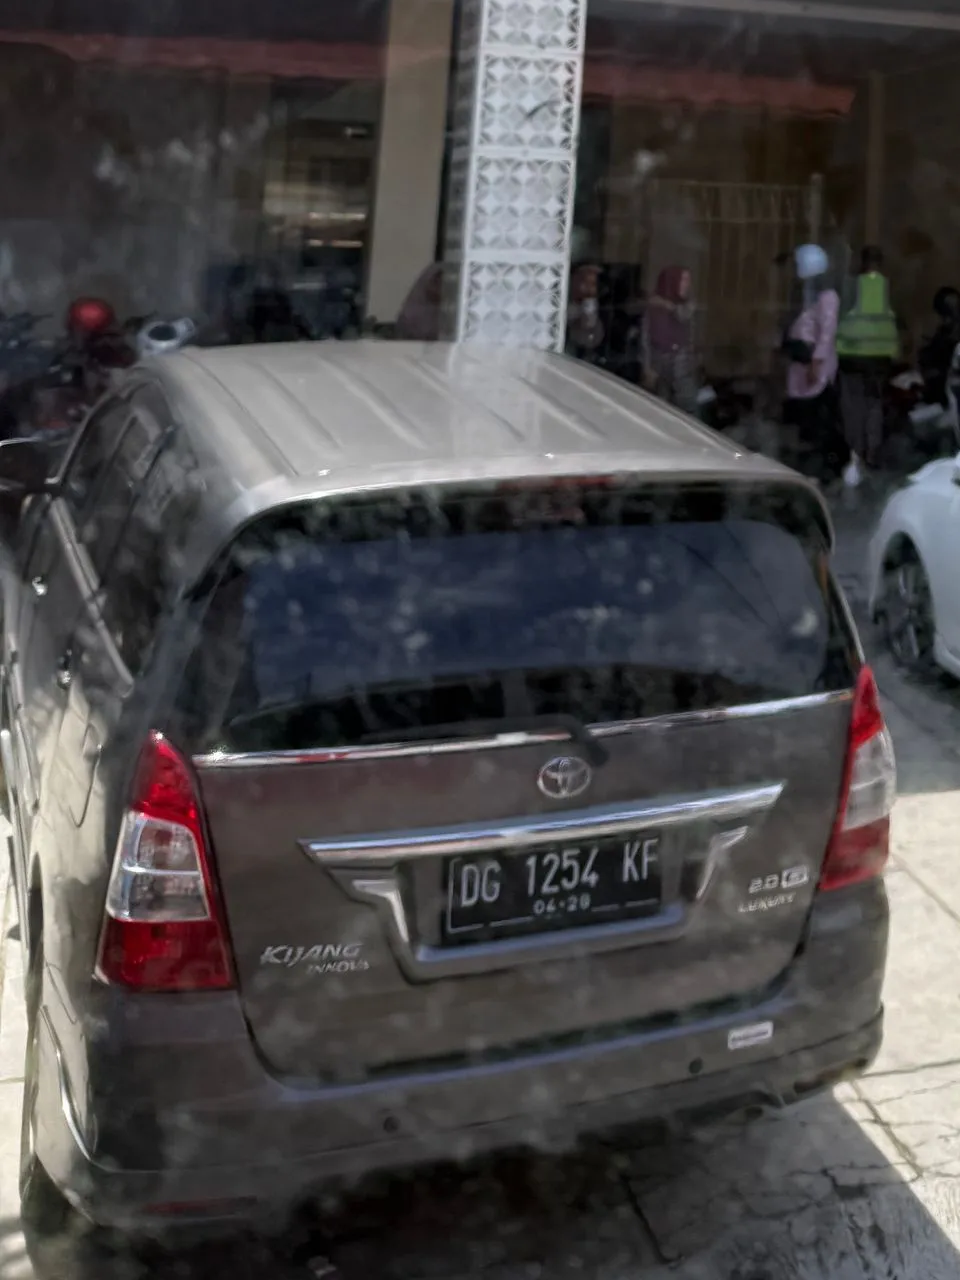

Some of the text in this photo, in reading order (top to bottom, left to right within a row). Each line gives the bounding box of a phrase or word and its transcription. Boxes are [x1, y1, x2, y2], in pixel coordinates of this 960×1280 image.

[460, 838, 659, 908] DG 1254 KF
[260, 942, 364, 968] KIJANG
